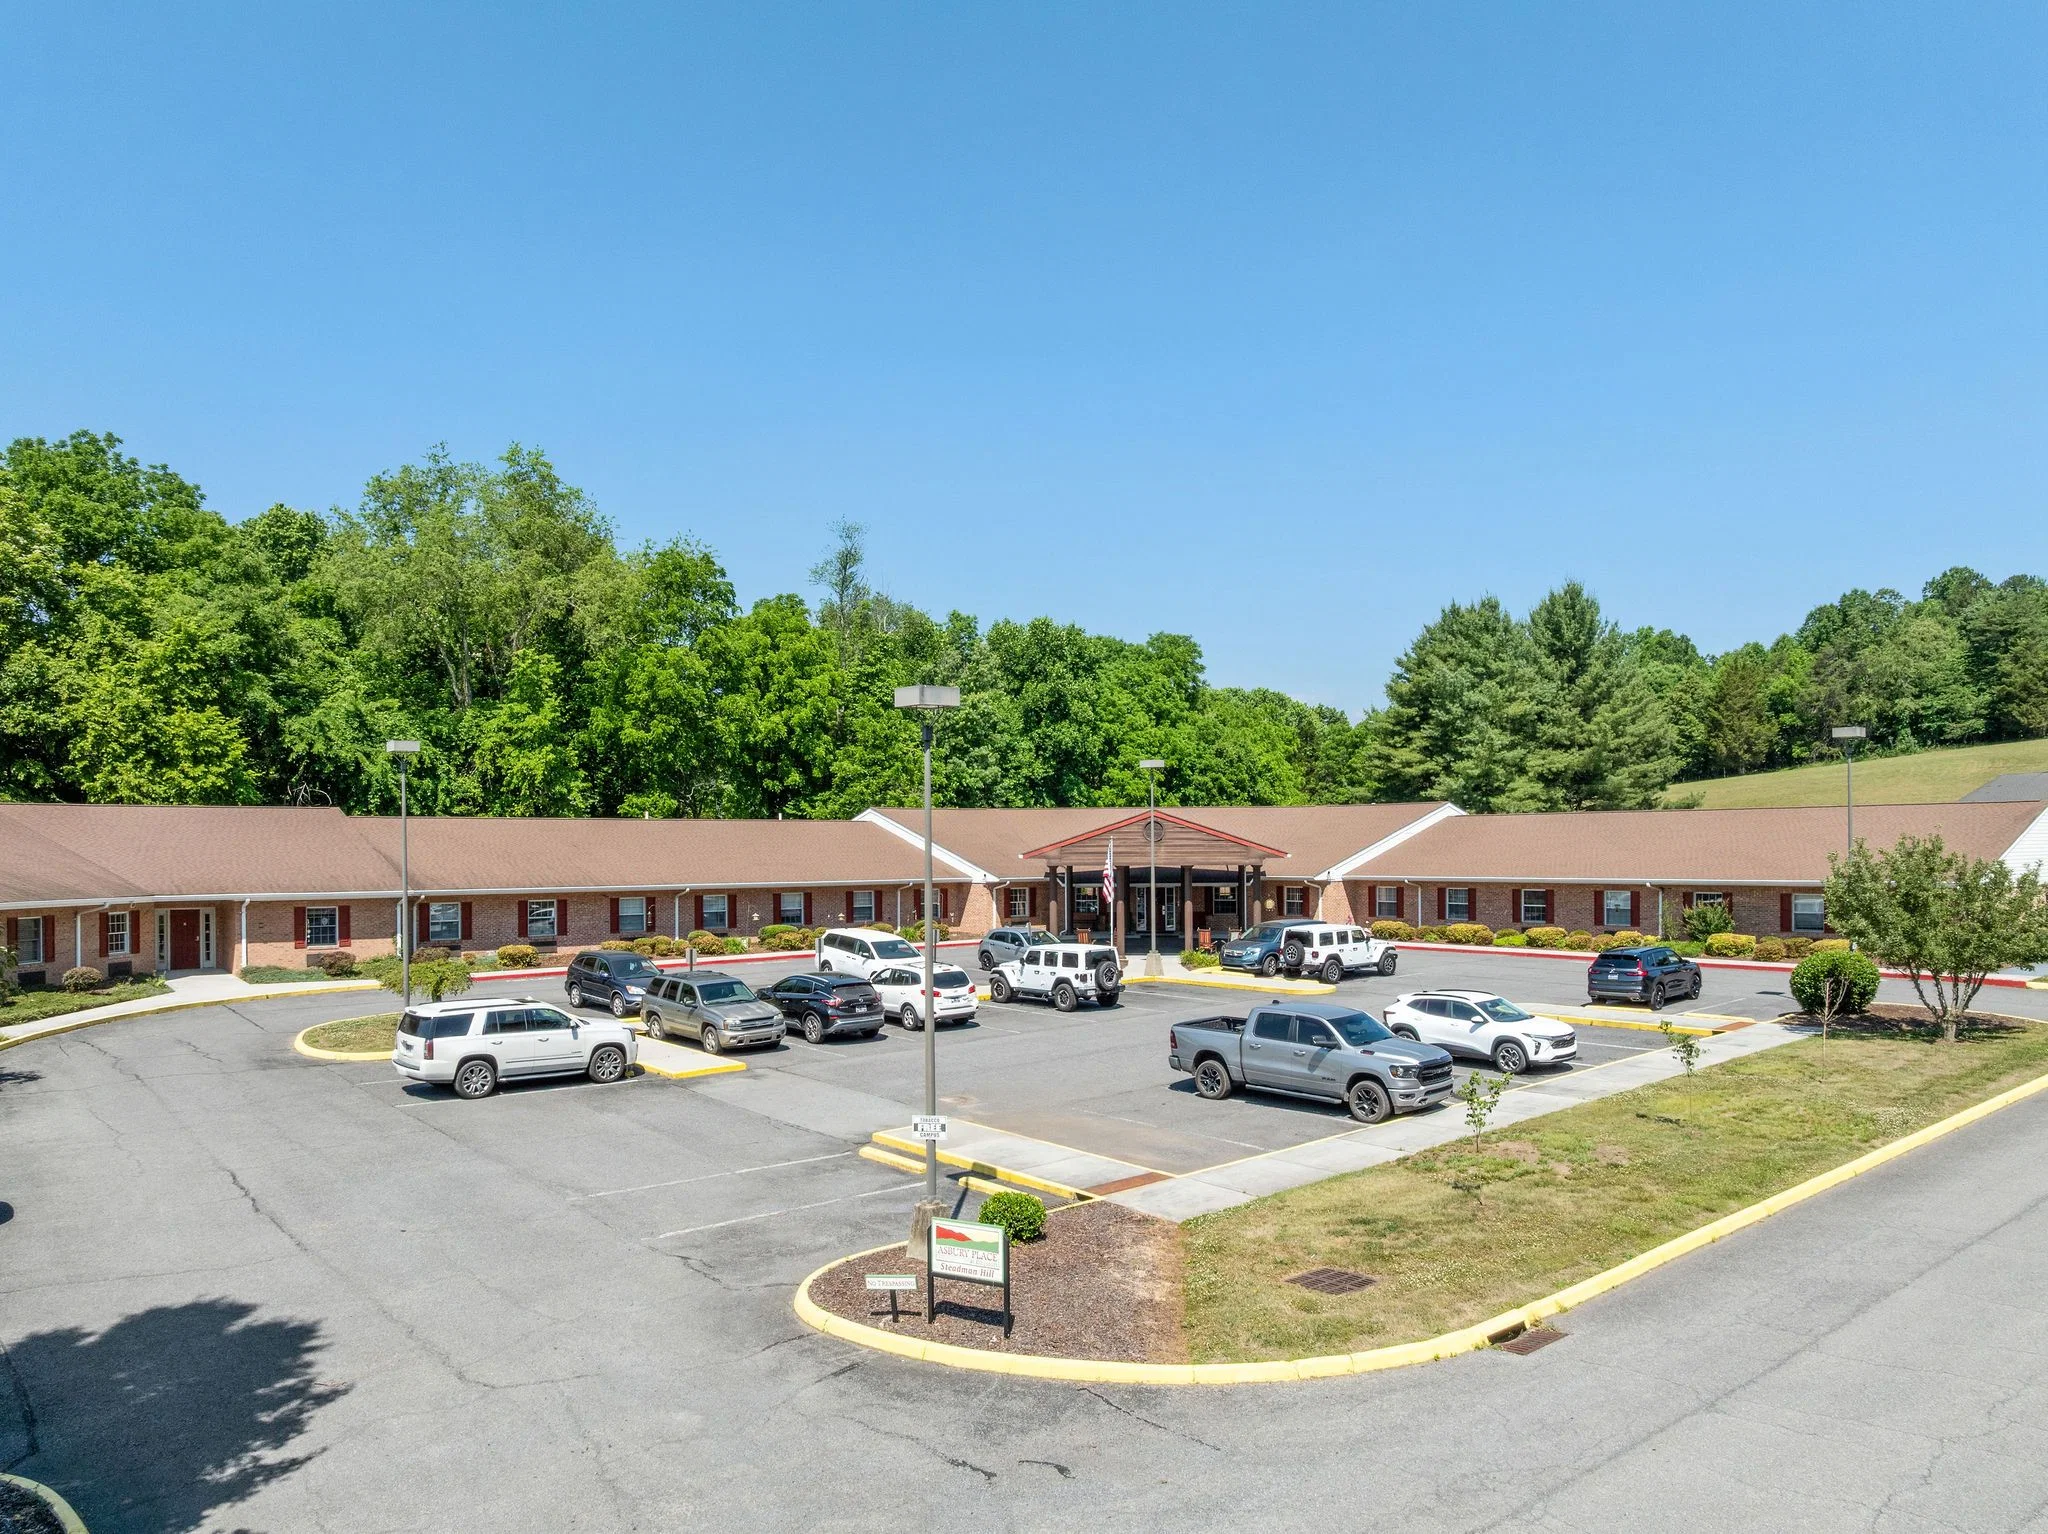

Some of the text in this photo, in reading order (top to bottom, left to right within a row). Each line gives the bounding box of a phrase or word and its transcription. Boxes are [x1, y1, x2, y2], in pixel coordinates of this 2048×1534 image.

[917, 1123, 942, 1132] FREE
[938, 1246, 998, 1262] ASBURY PLACE
[940, 1262, 978, 1275] Steadman
[980, 1268, 995, 1279] Hill
[877, 1280, 915, 1288] TRESPASSING
